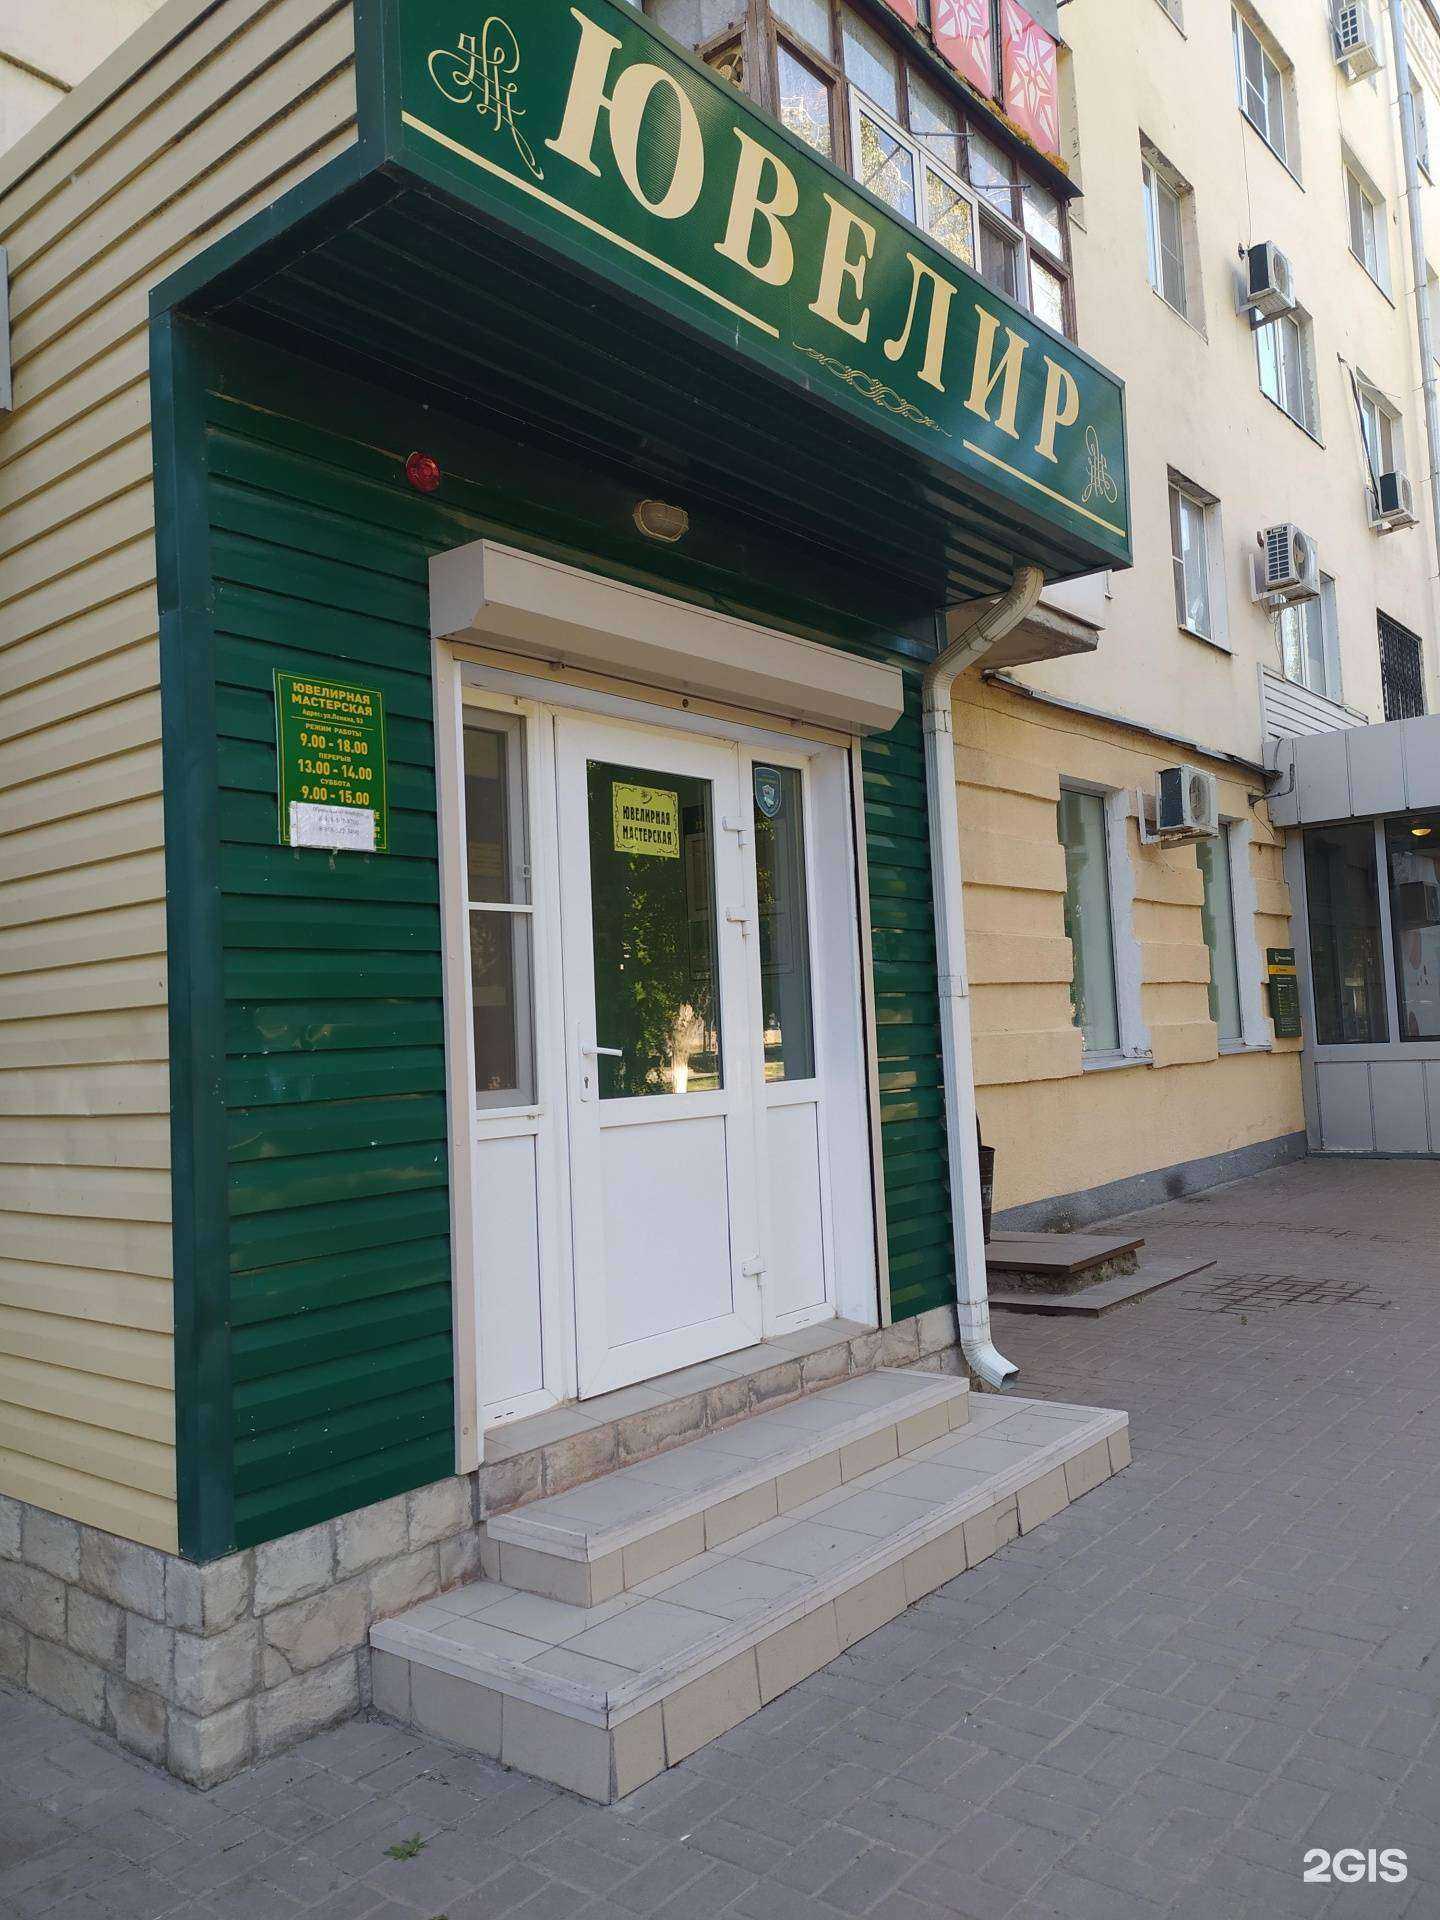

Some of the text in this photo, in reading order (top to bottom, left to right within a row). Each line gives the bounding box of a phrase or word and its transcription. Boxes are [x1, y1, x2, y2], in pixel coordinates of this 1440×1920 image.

[545, 6, 1081, 464] ЮВЕЛИР
[292, 682, 370, 705] ЮВЕЛИРНАЯ
[291, 693, 372, 716] МАСТЕРСКАЯ
[305, 723, 362, 738] РЕЖИМ РАБОТЫ
[300, 732, 325, 749] 9.00
[337, 738, 368, 755] 18.00
[318, 752, 352, 763] ПЕРЕРЫВ
[298, 758, 330, 775] 13.00
[341, 764, 372, 781] 14.00
[320, 778, 351, 788] СУББОТА
[301, 785, 328, 801] 9.00
[338, 789, 370, 806] 15.00
[622, 805, 671, 826] ЮВЕЛИРНАЯ
[622, 825, 673, 846] МАСТЕРСКАЯ
